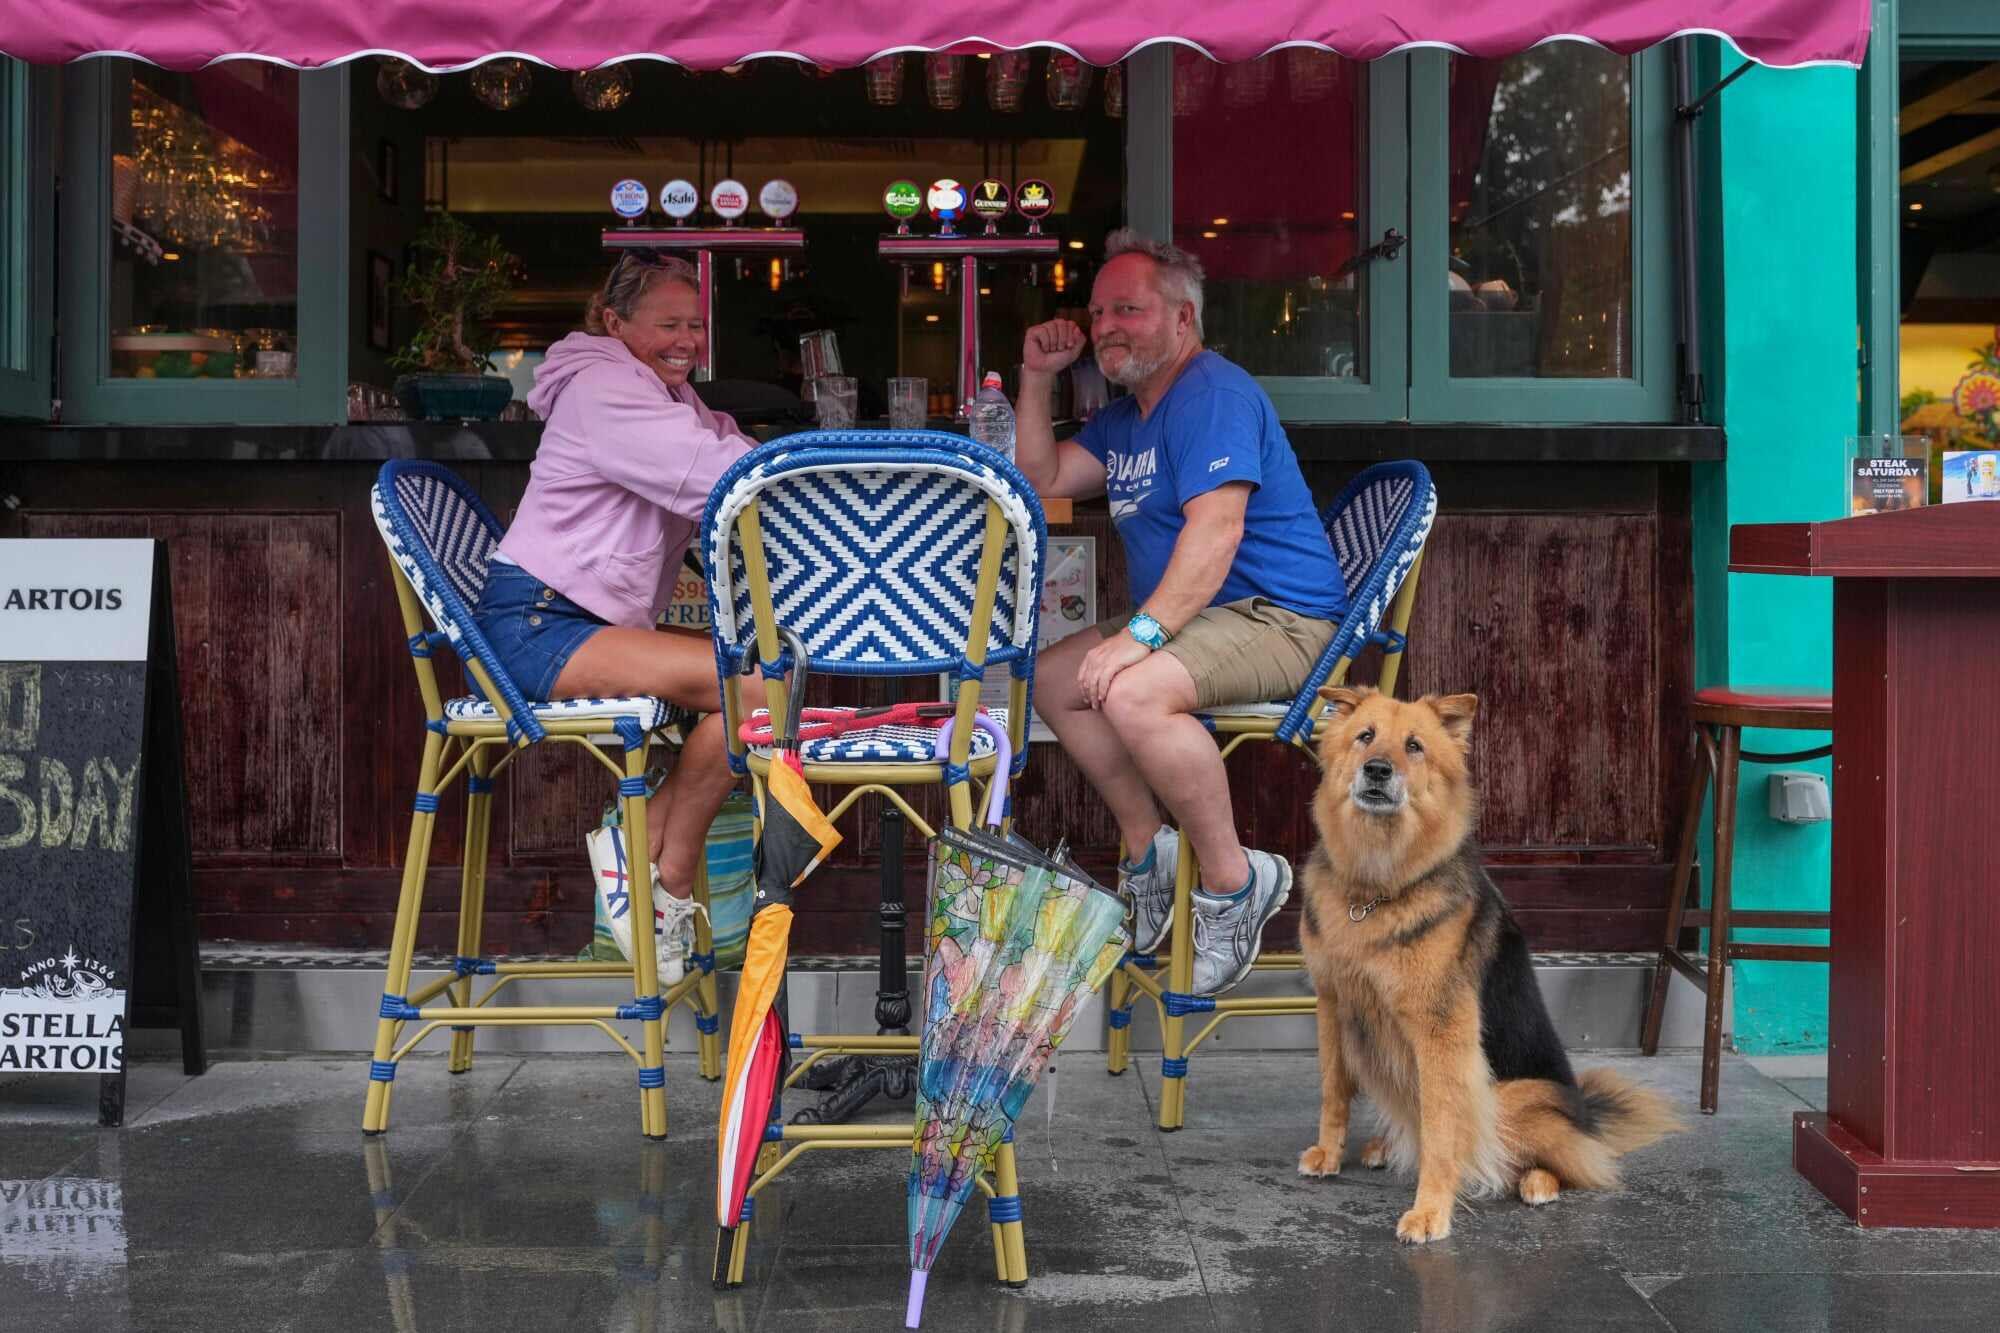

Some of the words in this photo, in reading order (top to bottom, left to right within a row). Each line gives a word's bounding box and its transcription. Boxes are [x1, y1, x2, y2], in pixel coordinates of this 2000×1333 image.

[663, 192, 695, 205] Asahi
[1858, 468, 1919, 476] SATURDAY
[4, 588, 123, 611] ARTOIS
[21, 957, 56, 981] ANNO
[84, 957, 116, 980] 1366
[2, 1012, 124, 1038] STELLA
[0, 1044, 122, 1070] ARTOIS
